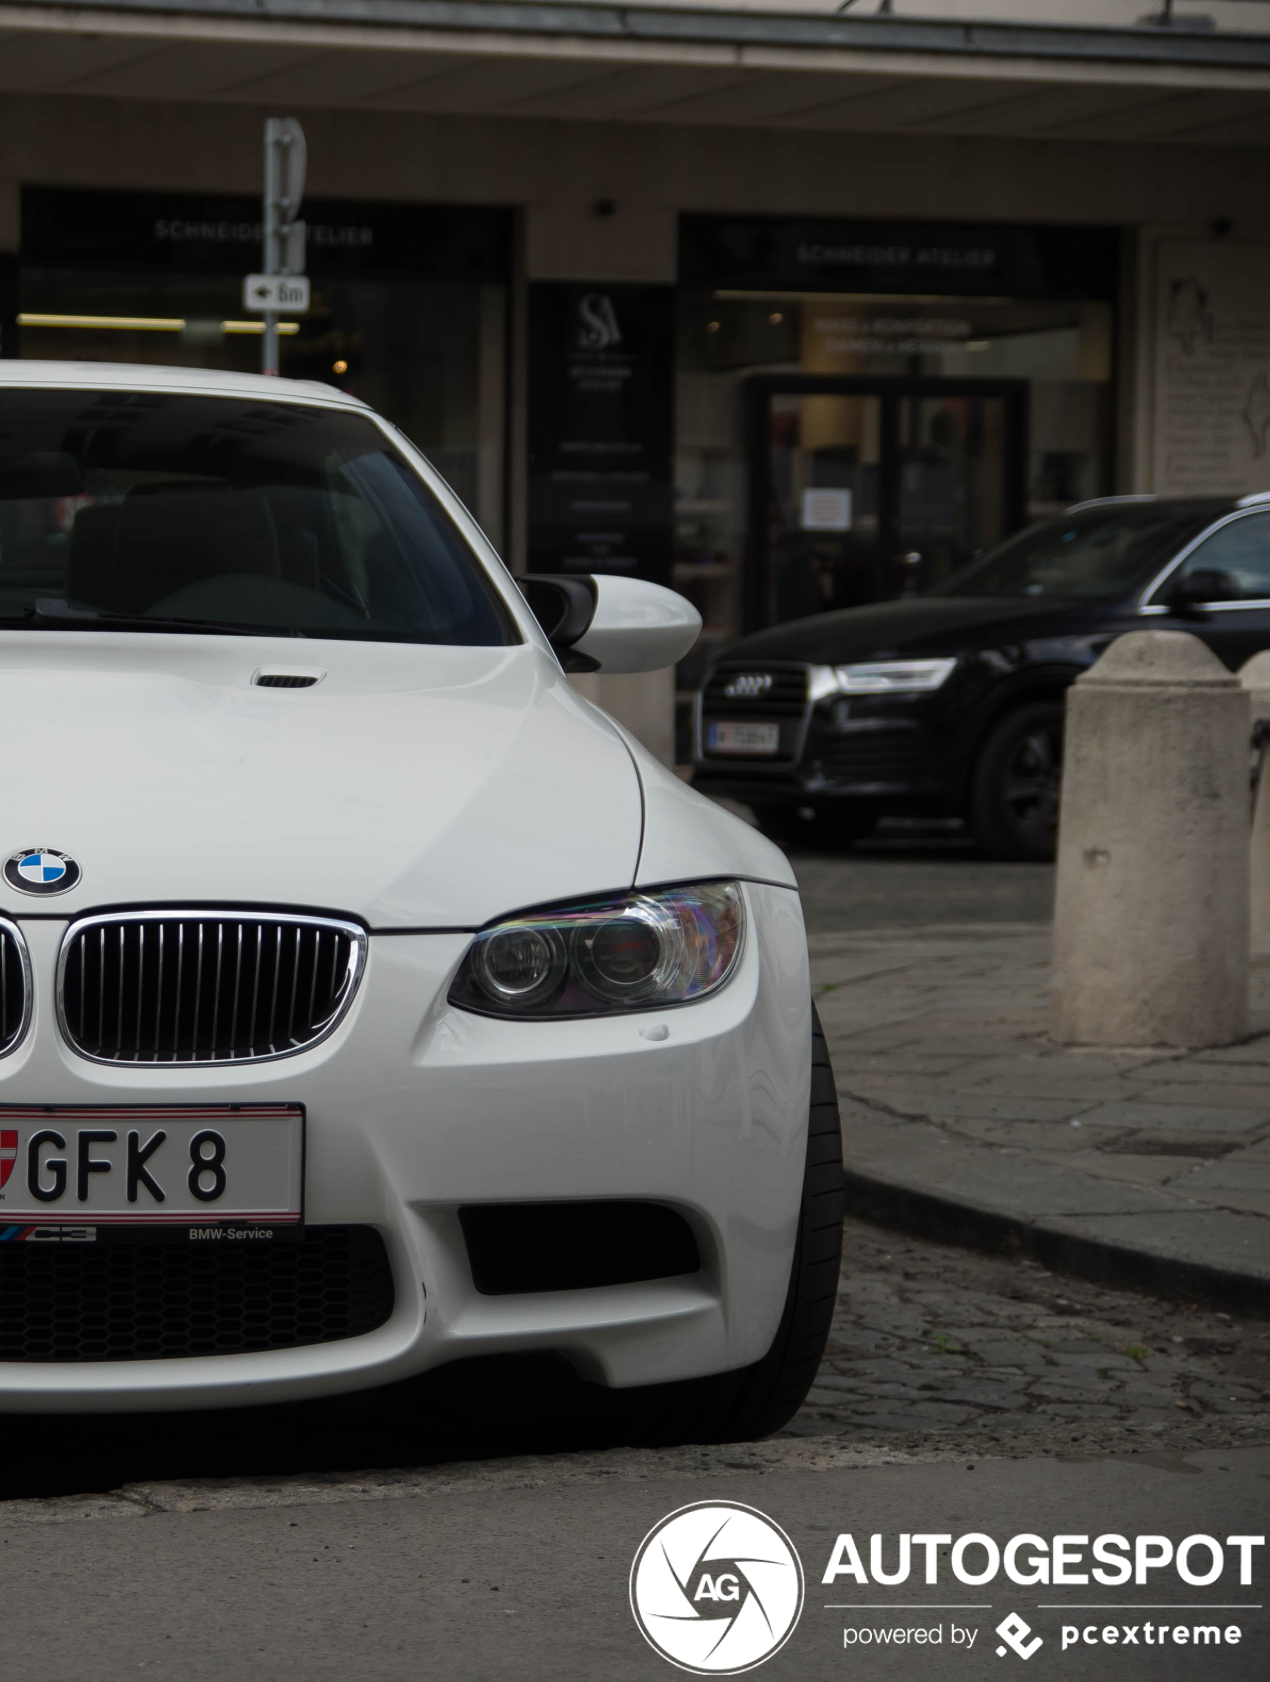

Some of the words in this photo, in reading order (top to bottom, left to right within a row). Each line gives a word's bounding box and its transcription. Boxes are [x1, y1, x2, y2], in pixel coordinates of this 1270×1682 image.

[153, 219, 262, 243] SCHNEIDE
[306, 225, 374, 247] TELIER
[796, 244, 911, 266] SCHNEIDER
[916, 247, 997, 268] ATELIER
[11, 848, 74, 861] BMW
[28, 1128, 166, 1203] GFK
[188, 1128, 227, 1203] 8
[189, 1227, 274, 1240] BMW-Service
